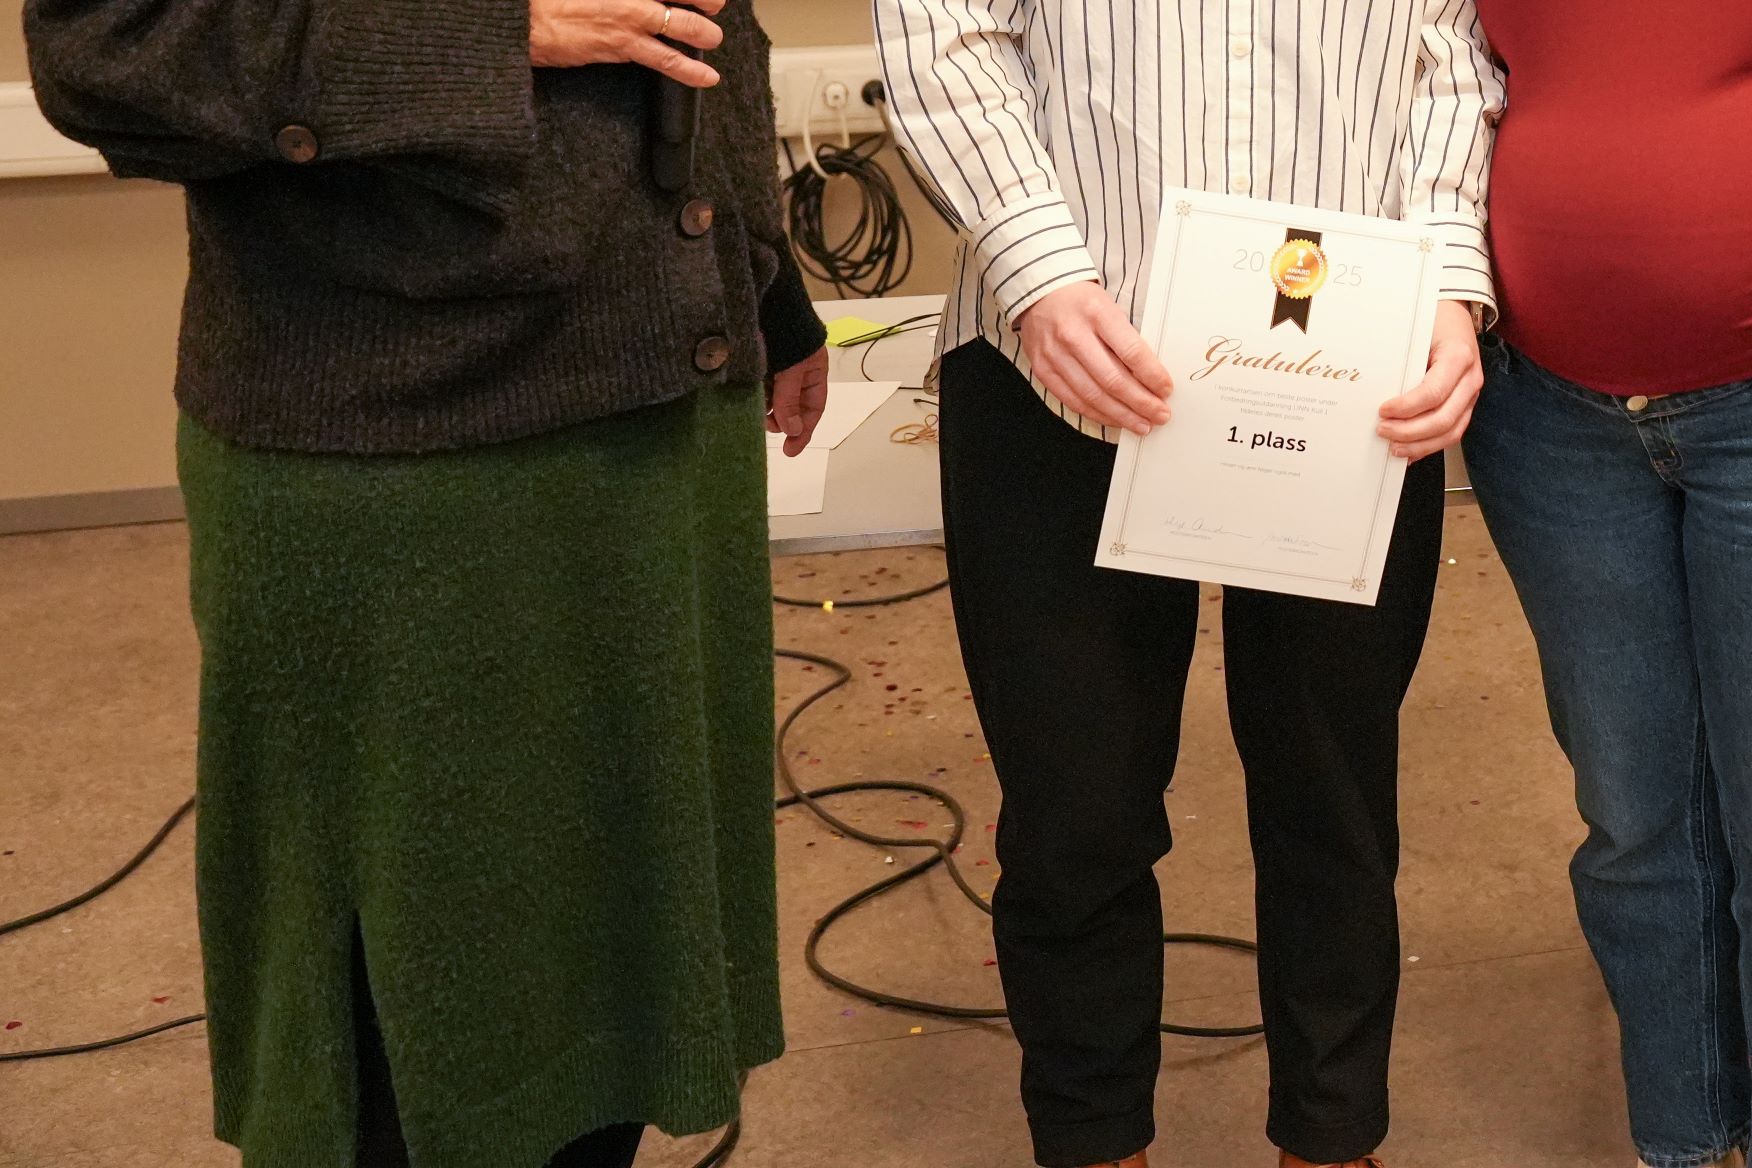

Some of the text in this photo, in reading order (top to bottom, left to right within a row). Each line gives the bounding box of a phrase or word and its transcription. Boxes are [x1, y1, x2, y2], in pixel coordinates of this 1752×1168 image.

[1233, 248, 1363, 287] 20 25
[1285, 267, 1311, 276] AWARD
[1189, 335, 1362, 382] Gratulerer
[1227, 425, 1307, 452] 1. plass
